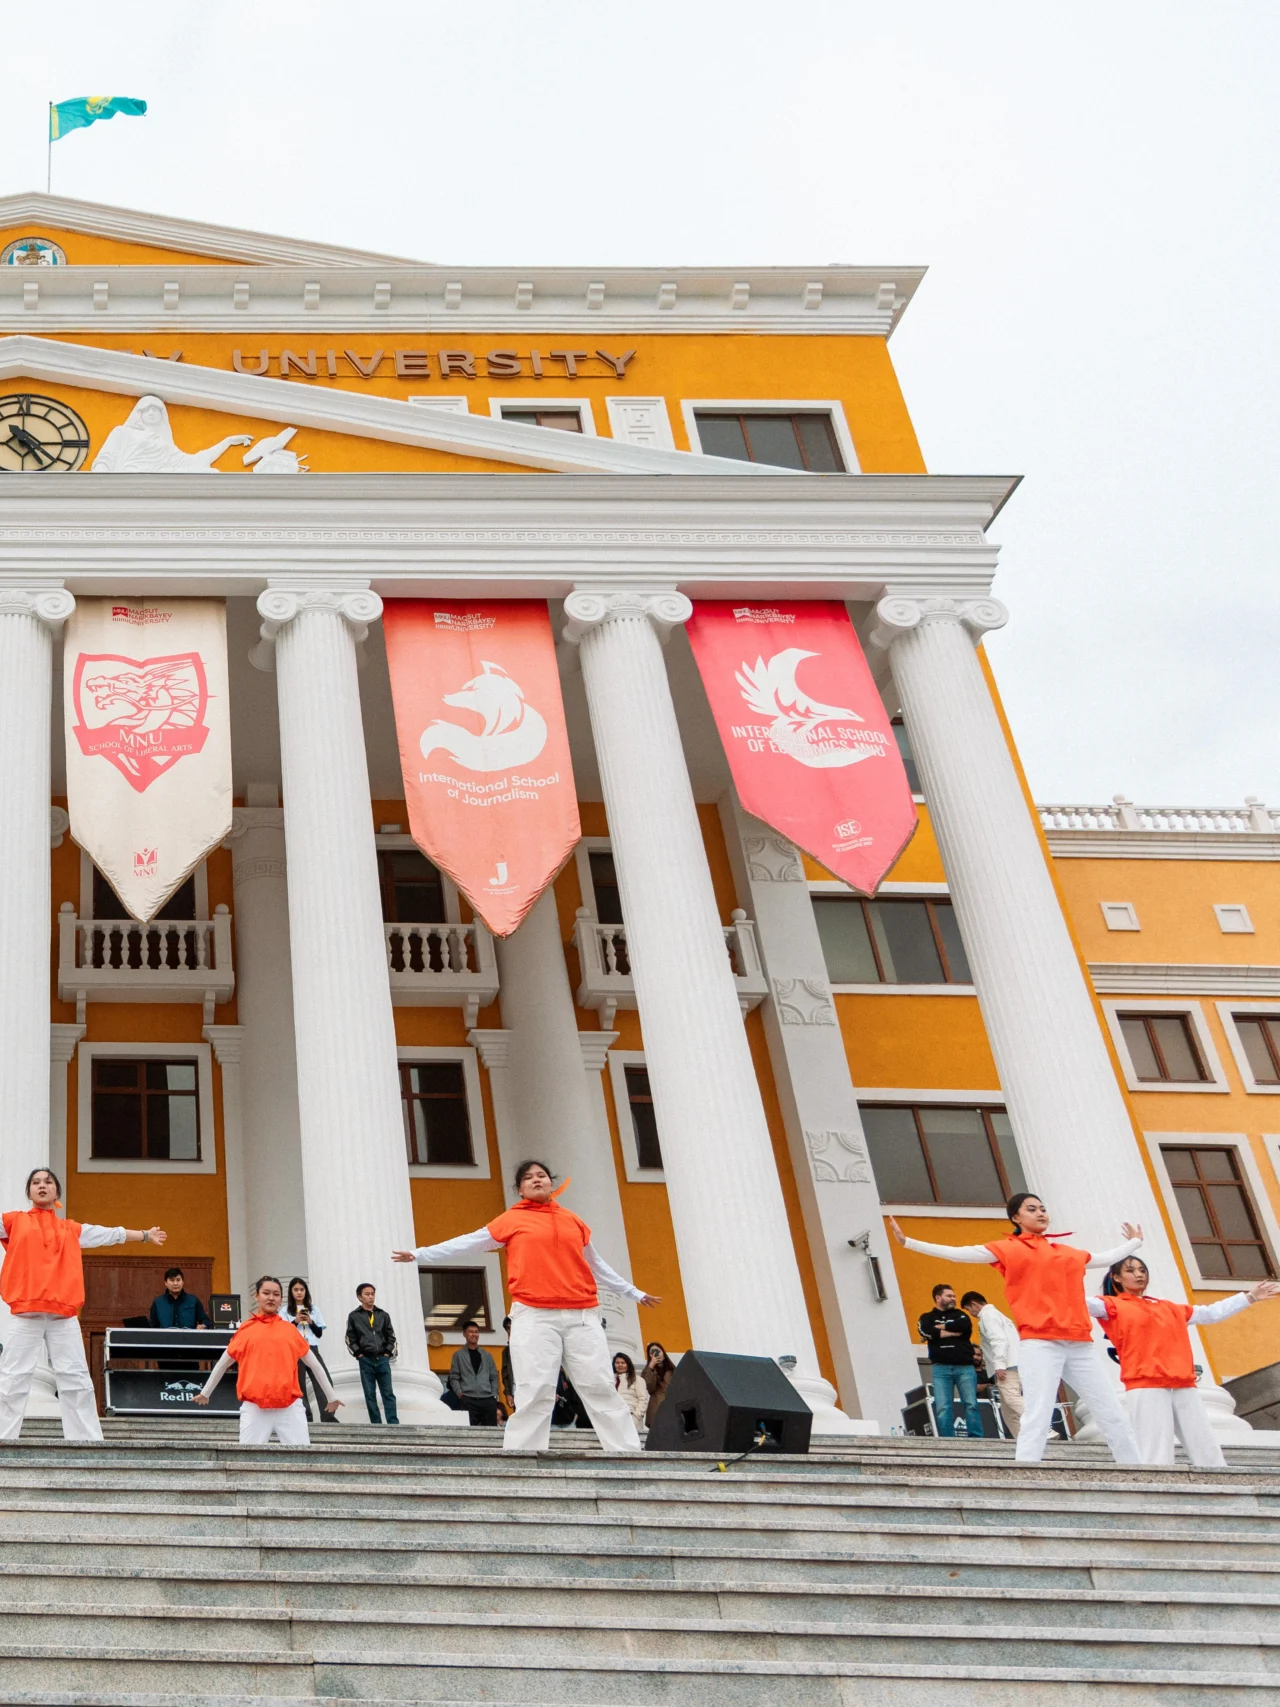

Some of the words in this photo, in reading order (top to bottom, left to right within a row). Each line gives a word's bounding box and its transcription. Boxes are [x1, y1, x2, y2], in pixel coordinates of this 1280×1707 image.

[232, 349, 637, 380] UNIVERSITY
[450, 613, 481, 621] MAQSUT
[120, 729, 162, 747] MNU
[731, 725, 836, 743] INTERNAL
[837, 727, 891, 746] SCHOOL
[88, 741, 120, 752] SCHOOL
[124, 745, 134, 753] OF
[136, 745, 168, 757] LIBERAL
[171, 744, 192, 752] ARTS
[747, 739, 765, 752] OF
[419, 772, 507, 794] International
[512, 772, 559, 787] School
[447, 788, 460, 799] of
[462, 788, 538, 806] Journalism
[836, 821, 859, 838] ISE
[160, 1392, 184, 1401] Red
